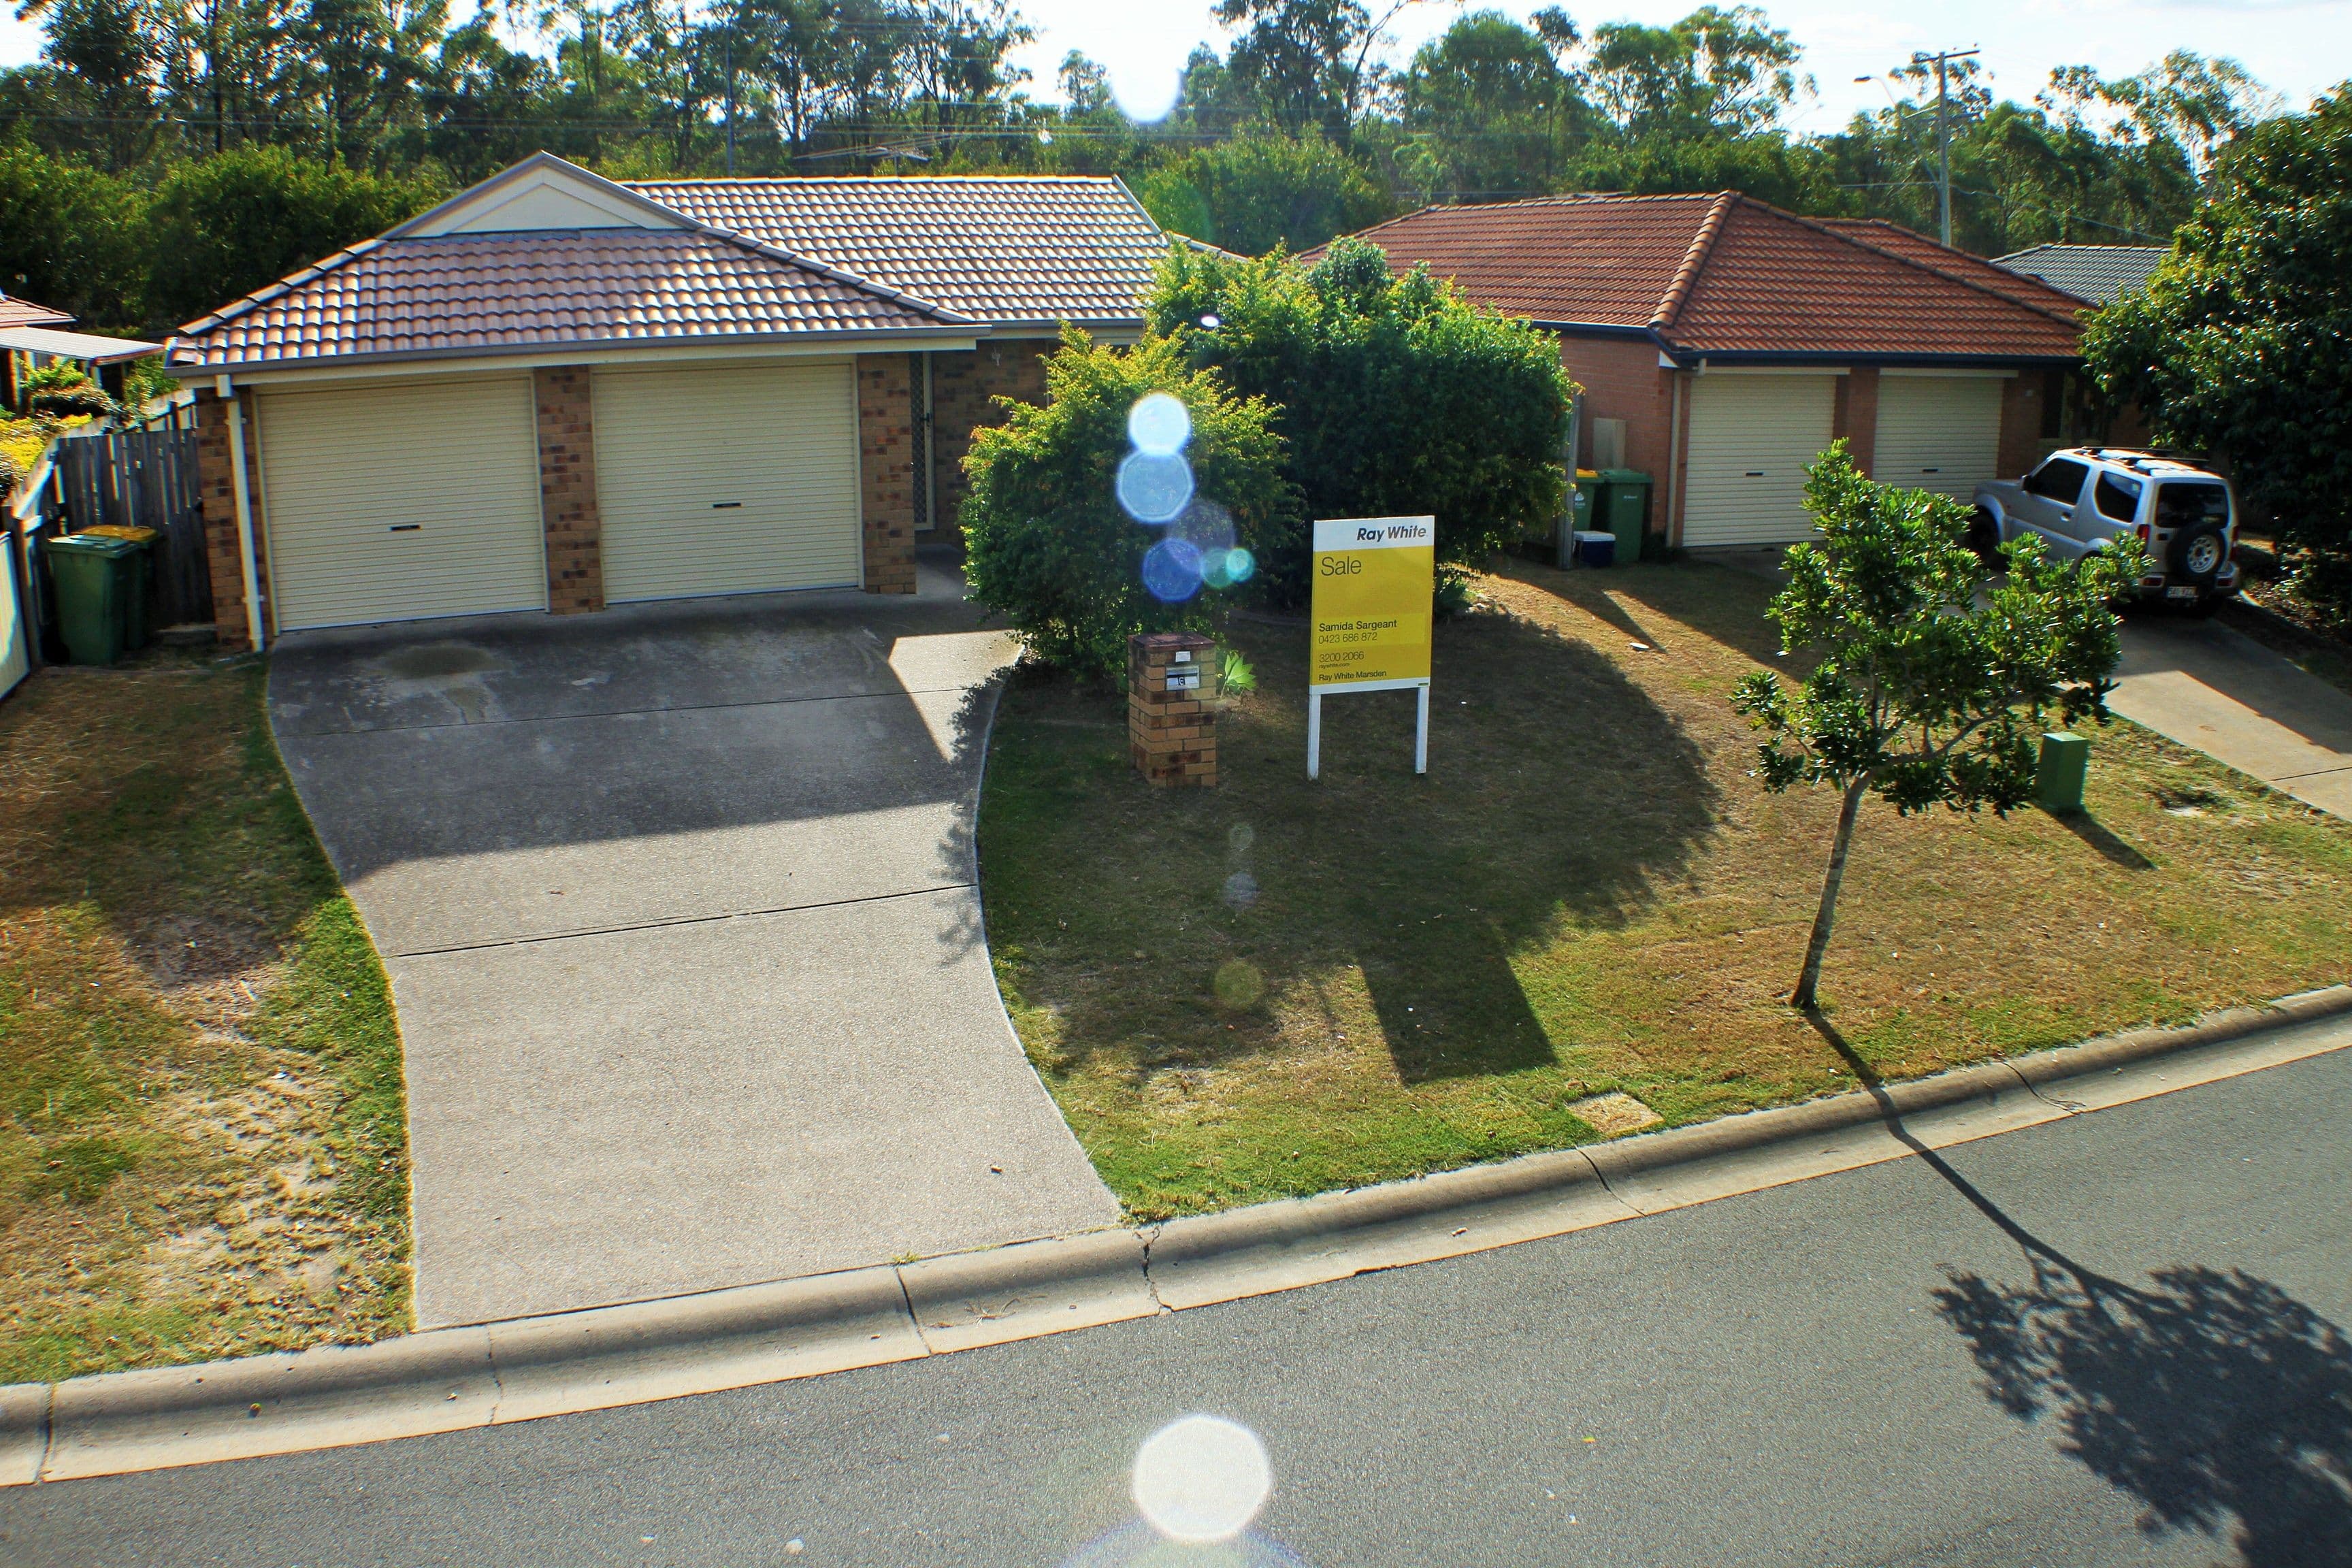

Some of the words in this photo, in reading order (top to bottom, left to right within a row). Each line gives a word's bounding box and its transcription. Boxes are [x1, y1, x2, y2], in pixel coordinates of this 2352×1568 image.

[1356, 527, 1385, 542] Ray
[1388, 525, 1427, 539] White
[1321, 555, 1362, 576] Sale
[1318, 622, 1354, 632] Samida
[1356, 619, 1397, 631] Sargeant
[1318, 634, 1341, 644] 0423
[1342, 633, 1360, 642] 686
[1360, 632, 1377, 641] 872
[1319, 653, 1341, 663] 3200
[1342, 651, 1365, 661] 2066
[1334, 672, 1354, 680] White
[1356, 670, 1387, 679] Marsden
